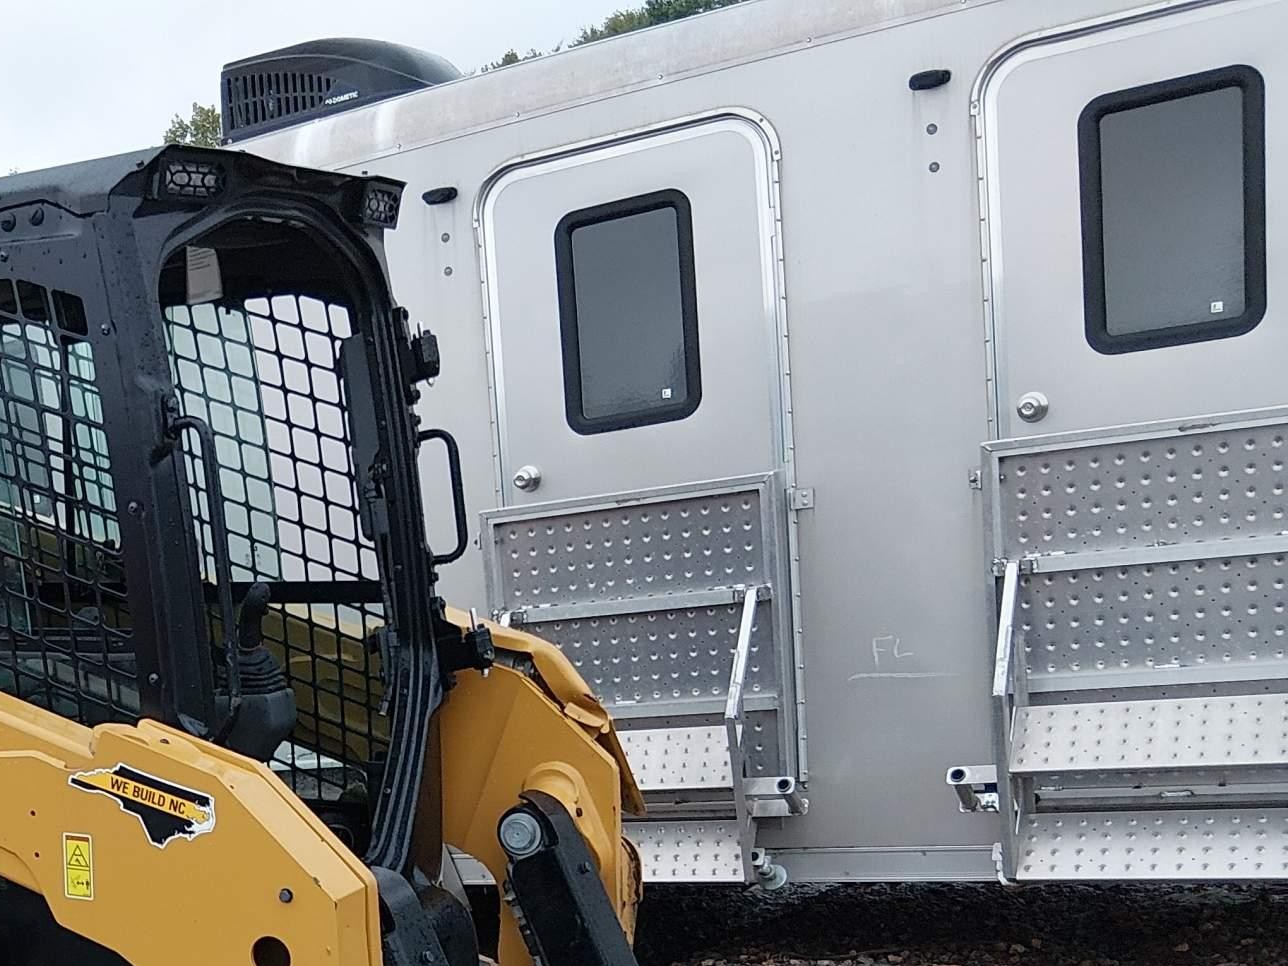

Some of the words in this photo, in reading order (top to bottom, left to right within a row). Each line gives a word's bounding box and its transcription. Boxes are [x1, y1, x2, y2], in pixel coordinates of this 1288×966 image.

[873, 635, 914, 665] FL
[111, 777, 129, 795] WE
[132, 787, 166, 807] BUILD
[169, 800, 187, 814] NC
